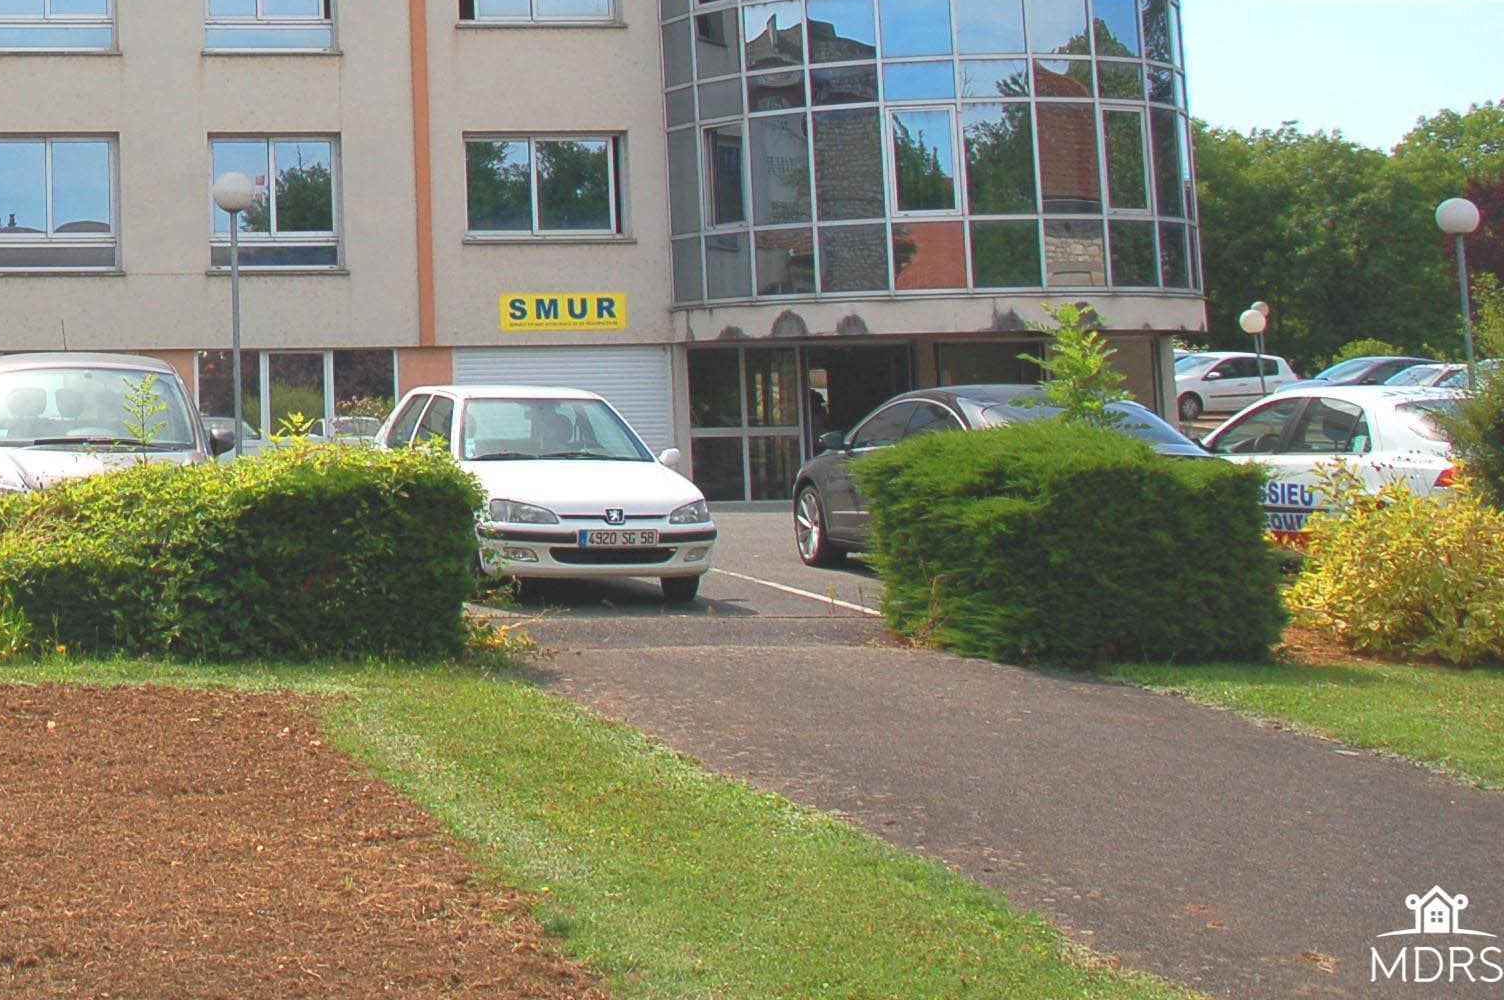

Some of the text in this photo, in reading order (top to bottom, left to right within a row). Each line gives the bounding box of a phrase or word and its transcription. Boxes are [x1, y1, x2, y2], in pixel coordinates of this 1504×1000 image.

[509, 297, 616, 320] SMUR
[589, 532, 616, 545] 4920
[622, 532, 636, 545] SG
